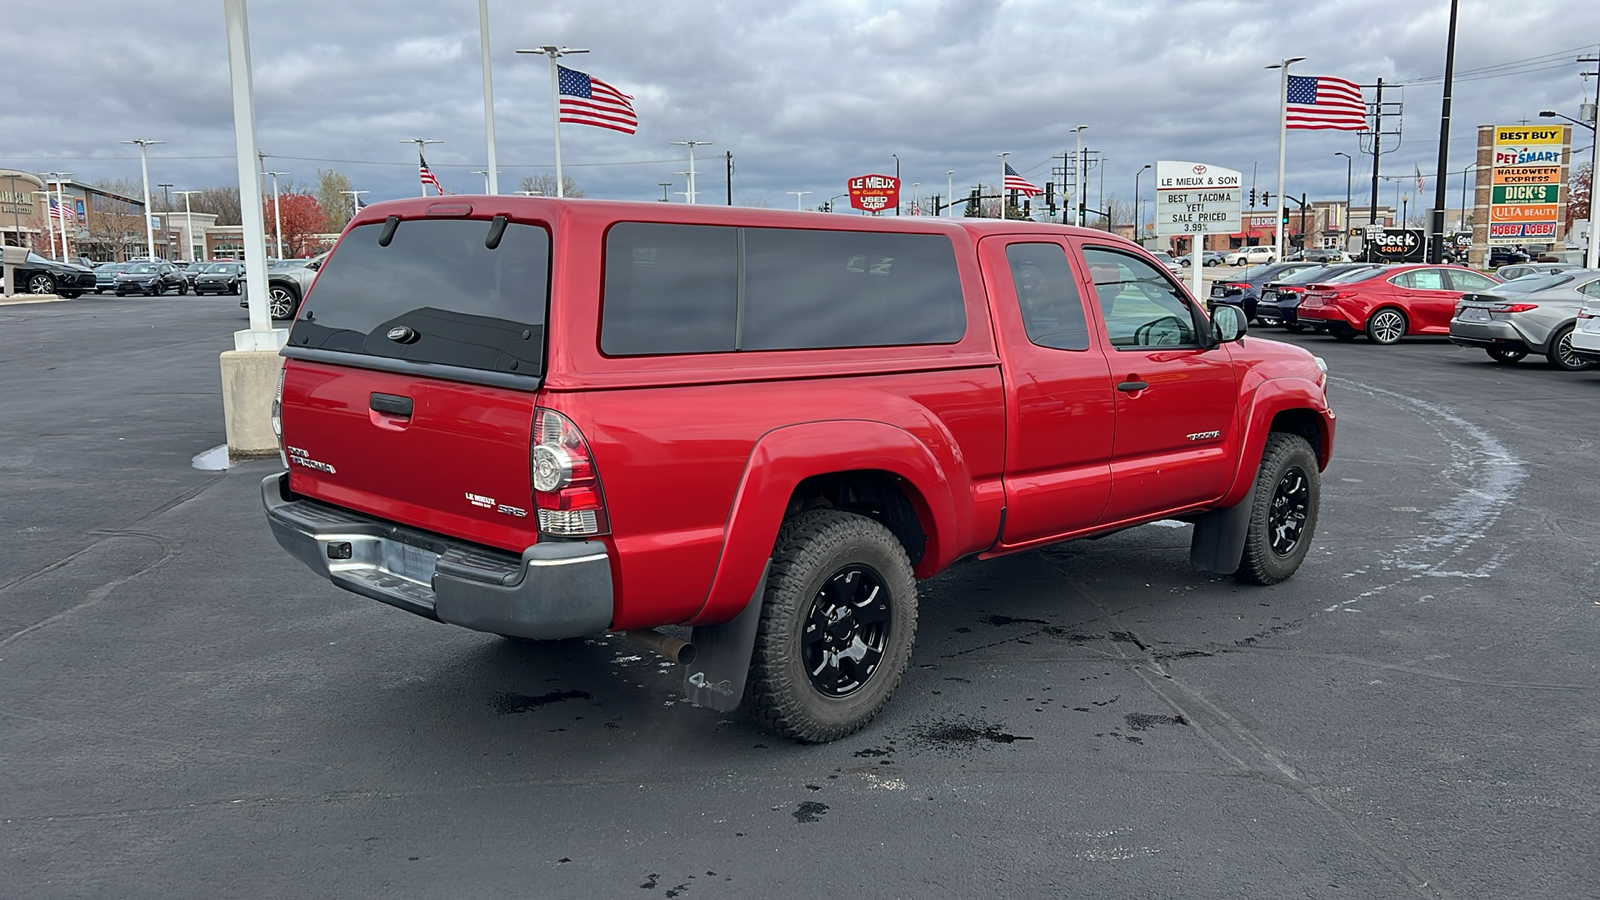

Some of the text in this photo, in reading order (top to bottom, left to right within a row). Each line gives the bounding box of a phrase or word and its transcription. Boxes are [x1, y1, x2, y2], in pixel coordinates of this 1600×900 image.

[1500, 131, 1558, 140] BEST BUY
[1496, 151, 1559, 164] PETSMART
[1497, 168, 1558, 176] HALLOWEEN
[852, 177, 895, 189] LE MIEUX
[1161, 176, 1238, 186] LE MIEUX & SON
[1504, 175, 1550, 183] EXPRESS
[1505, 185, 1547, 200] DICK'S
[1168, 193, 1231, 203] BEST TACOMA
[1186, 203, 1204, 212] YET!
[1496, 207, 1556, 217] ULTA BEAUTY
[1172, 212, 1227, 222] SALE PRICED
[1184, 223, 1208, 232] 3.99%
[1490, 224, 1555, 237] HOBBY LOBBY
[1186, 430, 1220, 441] TACOMA
[465, 492, 475, 501] LE
